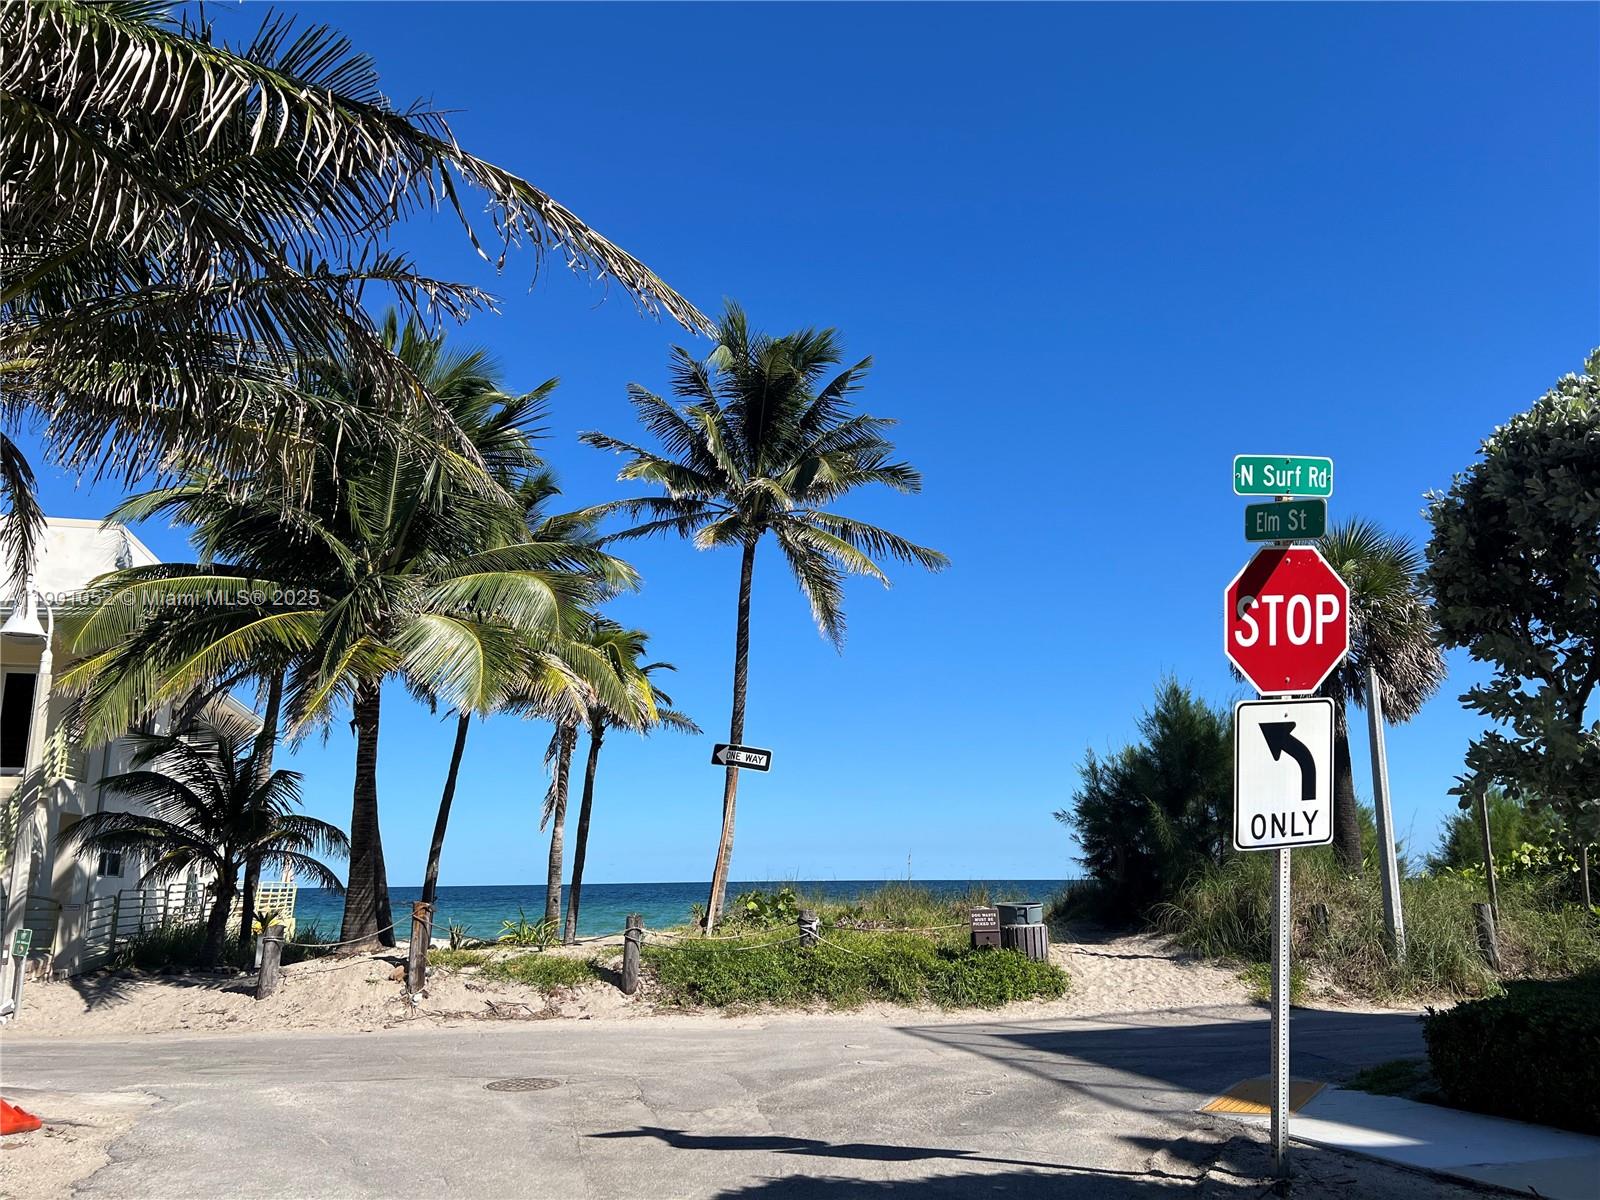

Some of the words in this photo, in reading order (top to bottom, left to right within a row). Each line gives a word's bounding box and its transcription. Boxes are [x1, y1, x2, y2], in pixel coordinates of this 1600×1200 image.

[1241, 464, 1254, 487] N
[1263, 464, 1302, 487] Surf
[1308, 466, 1327, 488] Rd
[1256, 511, 1280, 533] Elm
[1287, 508, 1307, 531] St
[1234, 593, 1340, 647] STOP
[726, 751, 741, 761] ONE
[745, 753, 764, 764] WAY
[1251, 809, 1319, 841] ONLY
